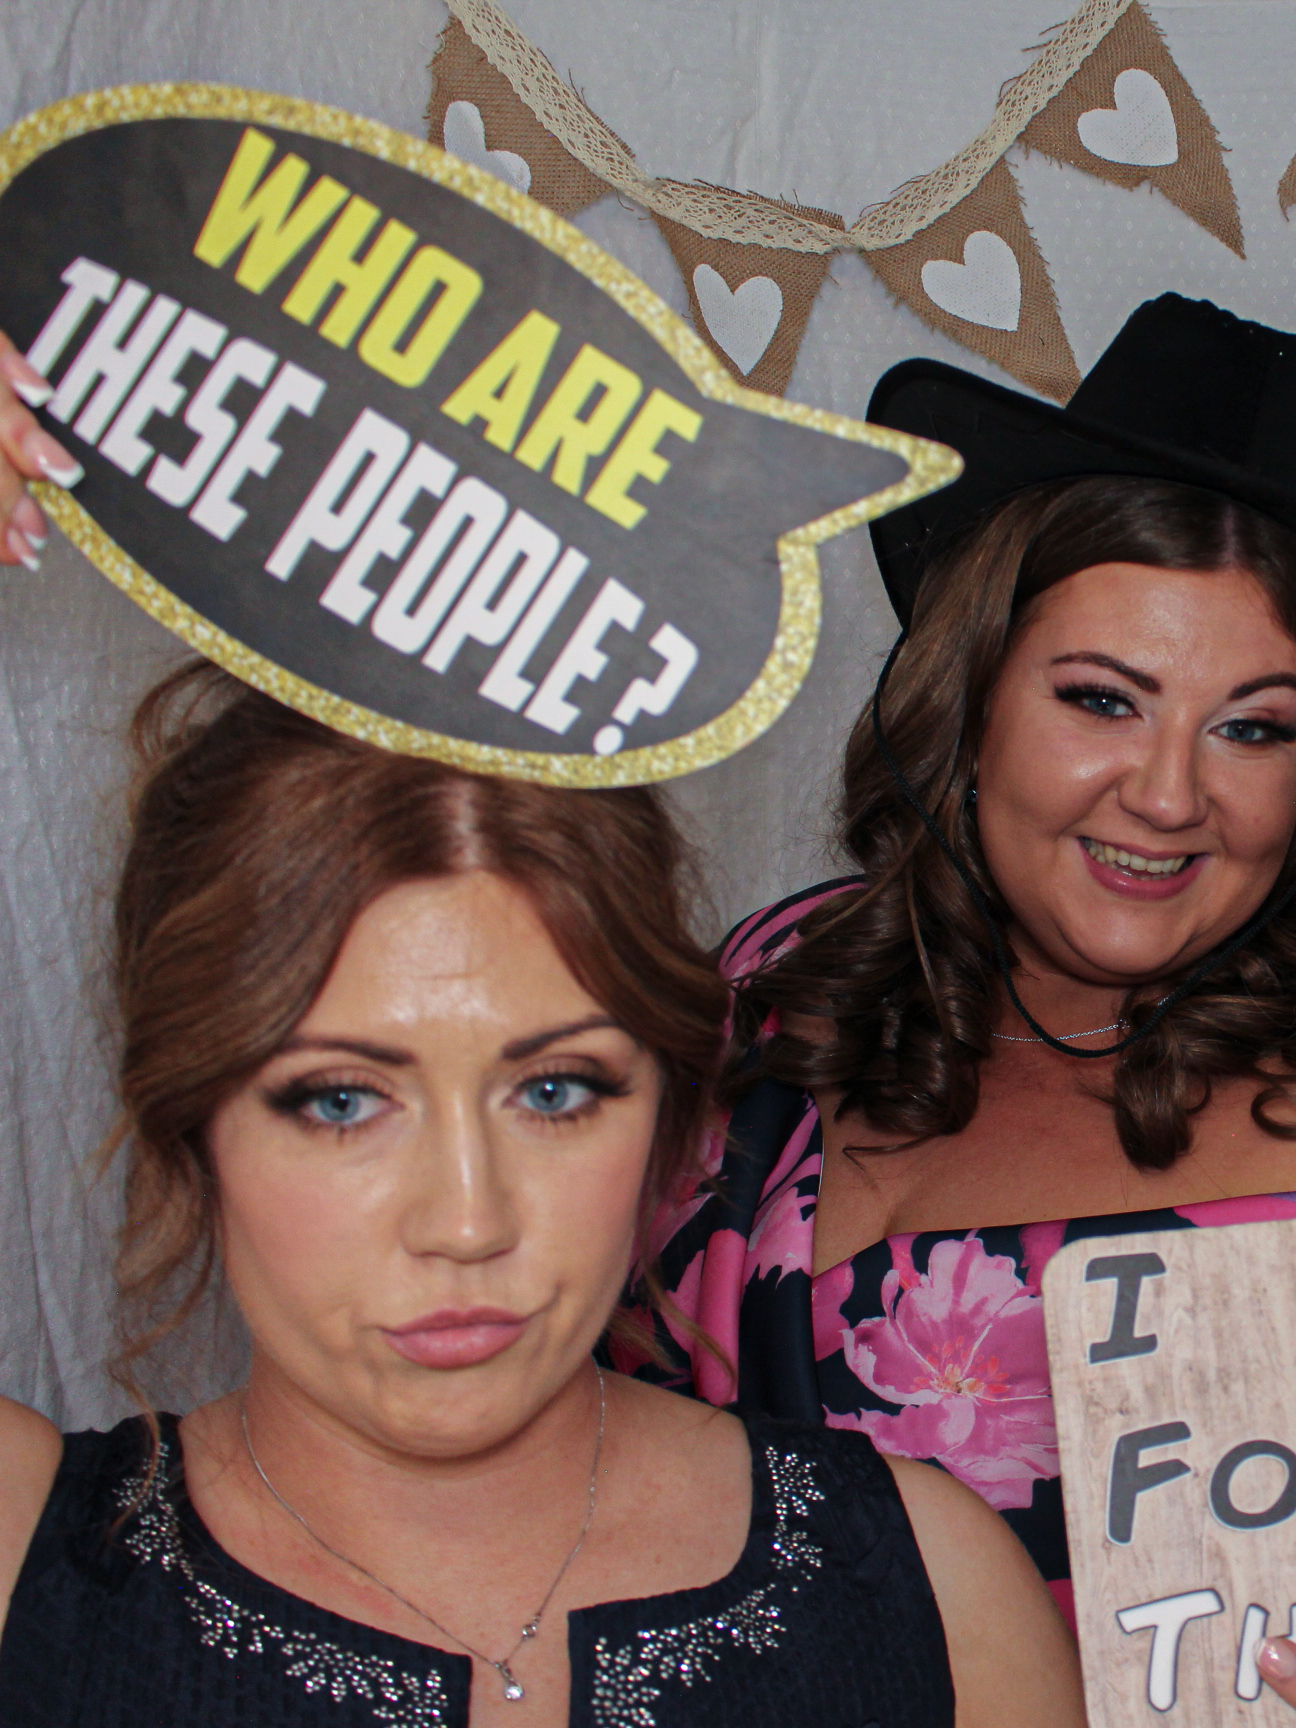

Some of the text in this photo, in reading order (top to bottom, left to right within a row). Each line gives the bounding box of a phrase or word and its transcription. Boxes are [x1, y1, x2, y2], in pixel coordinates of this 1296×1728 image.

[27, 258, 698, 755] THESE PEOPLE?
[194, 127, 703, 529] WHO ARE
[1085, 1252, 1167, 1364] I
